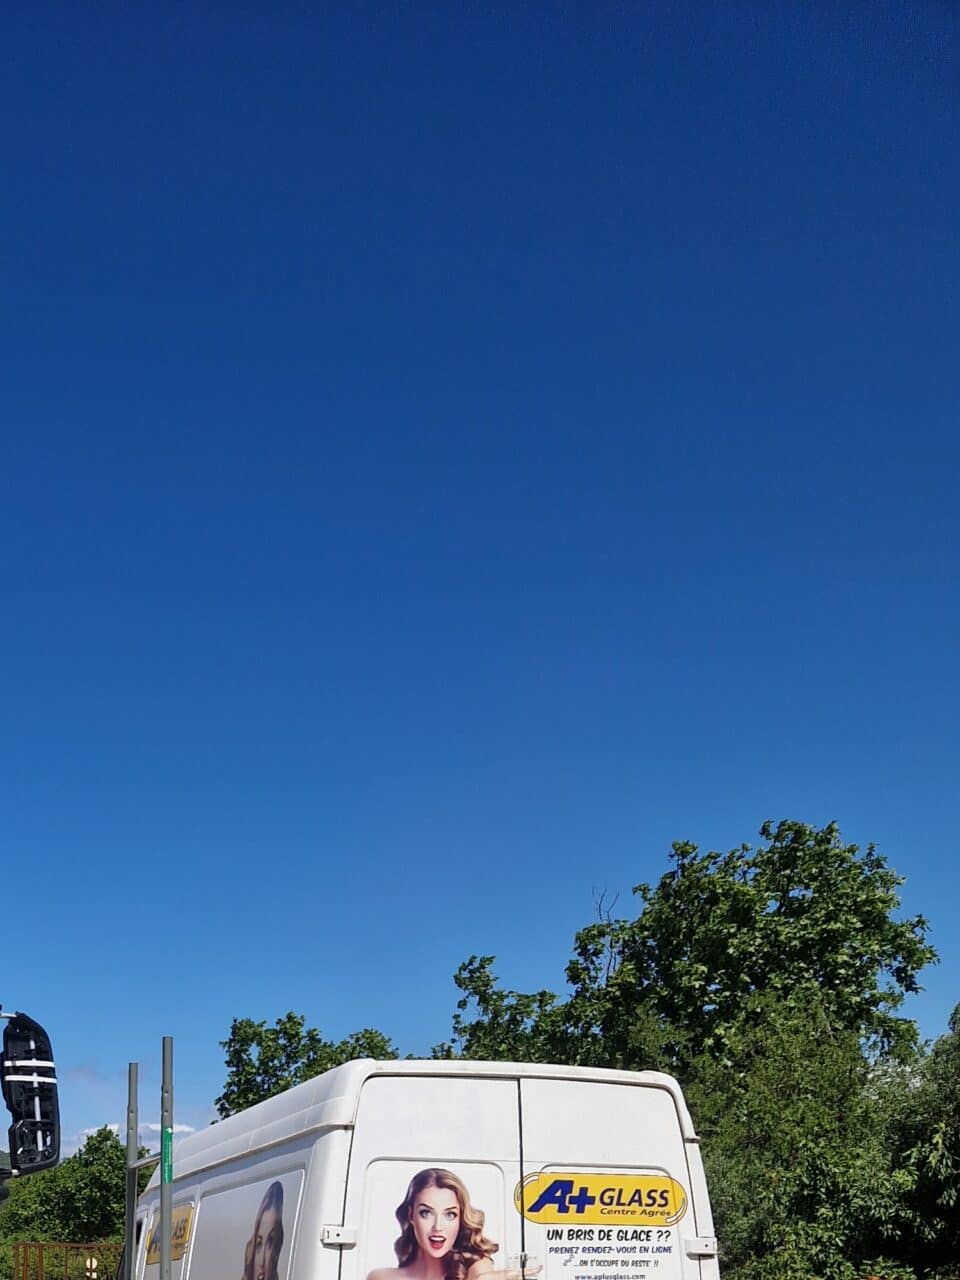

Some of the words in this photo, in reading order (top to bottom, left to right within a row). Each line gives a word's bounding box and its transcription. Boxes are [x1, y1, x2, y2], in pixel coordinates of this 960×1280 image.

[527, 1179, 596, 1214] A+
[599, 1187, 670, 1208] GLASS
[600, 1208, 637, 1216] Centre
[546, 1229, 564, 1241] UN
[567, 1229, 595, 1241] BRIS
[598, 1229, 613, 1241] DE
[616, 1229, 652, 1242] GLACE
[656, 1230, 672, 1242] ??
[549, 1246, 579, 1255] PRENEZ
[639, 1246, 649, 1254] EN
[651, 1246, 673, 1254] LIGNE
[620, 1260, 630, 1268] DU
